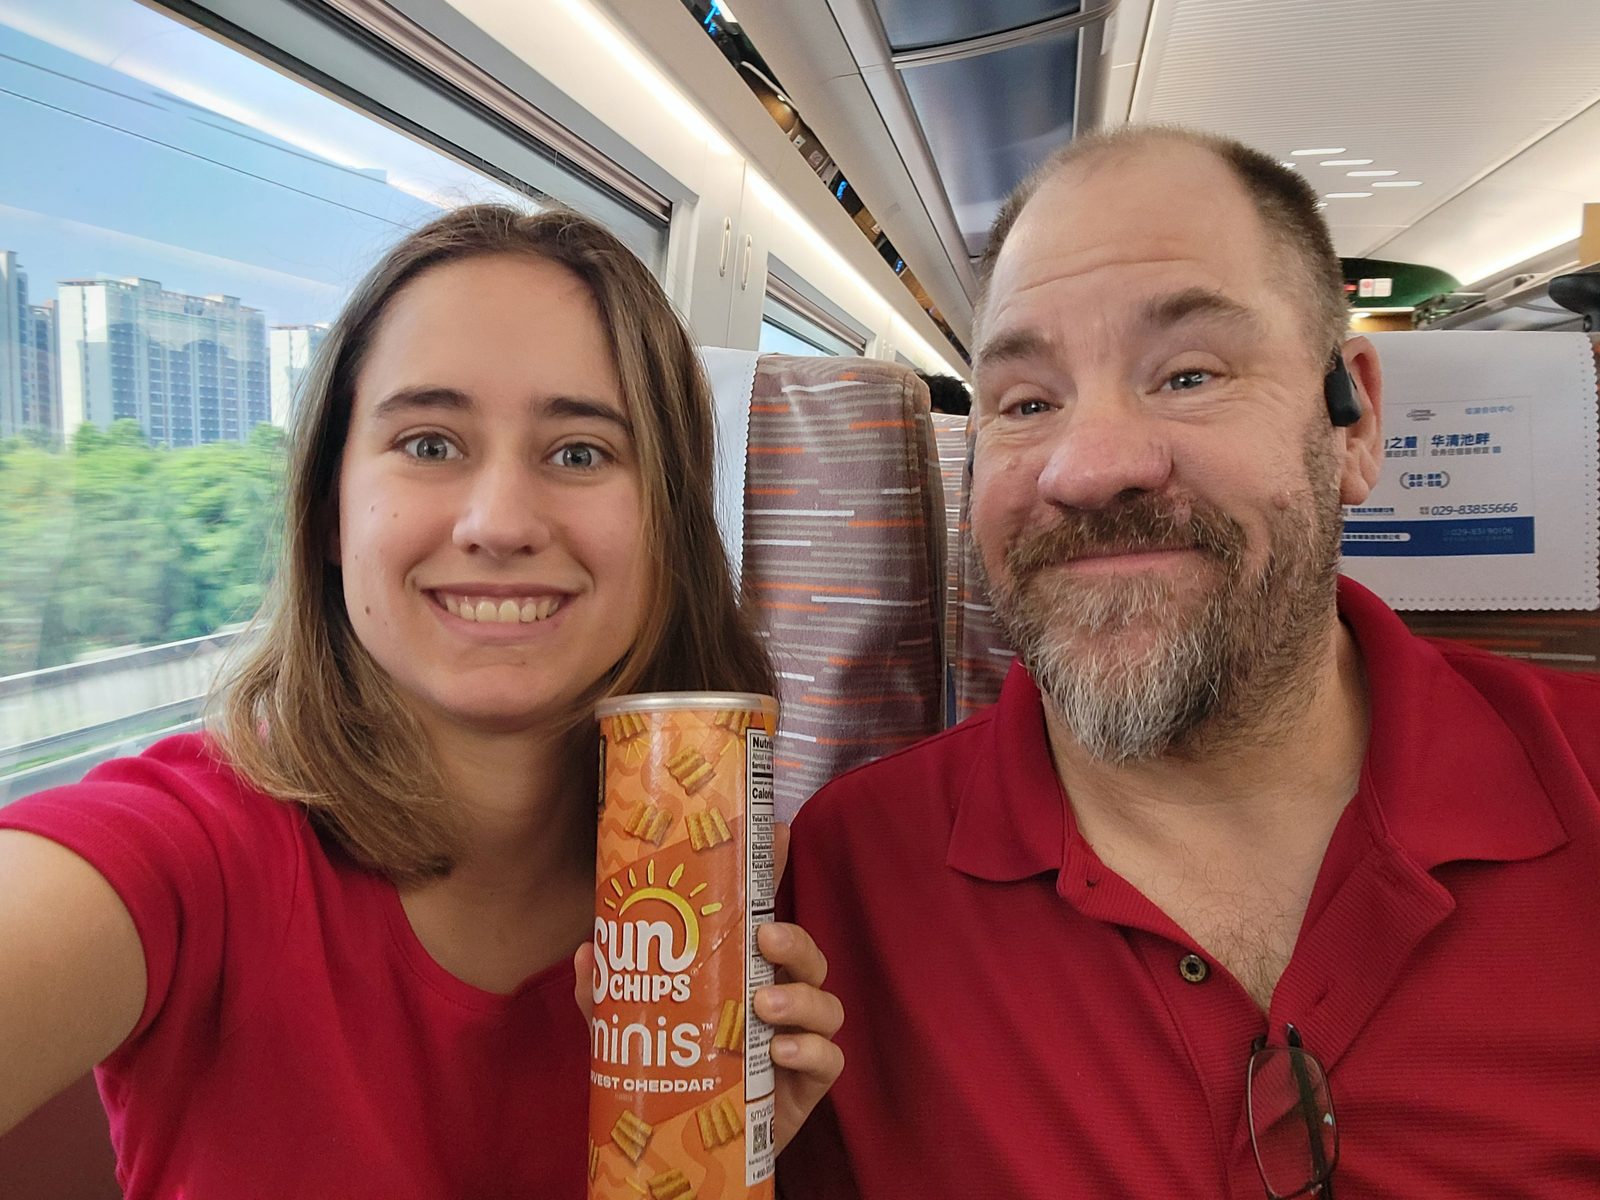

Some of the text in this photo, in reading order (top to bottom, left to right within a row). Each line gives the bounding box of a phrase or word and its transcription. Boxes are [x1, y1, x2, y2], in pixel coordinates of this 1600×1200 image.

[1431, 432, 1490, 447] 华清池畔
[1431, 502, 1518, 516] 029-83855666
[593, 916, 700, 1004] Sun
[609, 973, 691, 1003] CHIPS
[592, 1013, 701, 1068] minis
